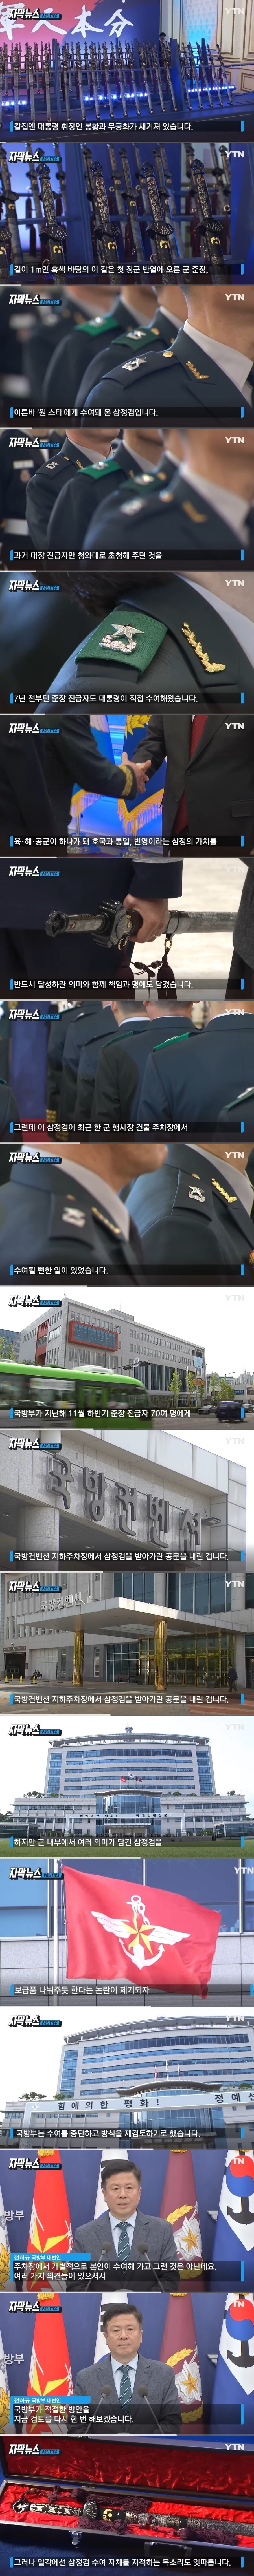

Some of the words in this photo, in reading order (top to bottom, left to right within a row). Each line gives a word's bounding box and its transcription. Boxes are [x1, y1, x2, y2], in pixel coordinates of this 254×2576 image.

[0, 1, 134, 41] 軍人本分
[50, 1454, 200, 1560] 국방컨벤션
[40, 1592, 82, 1612] 국방컨벤션
[58, 2100, 109, 2110] 힘에의한
[124, 2098, 159, 2108] 평화!
[4, 2210, 25, 2221] 방부
[4, 2354, 24, 2365] 방부
